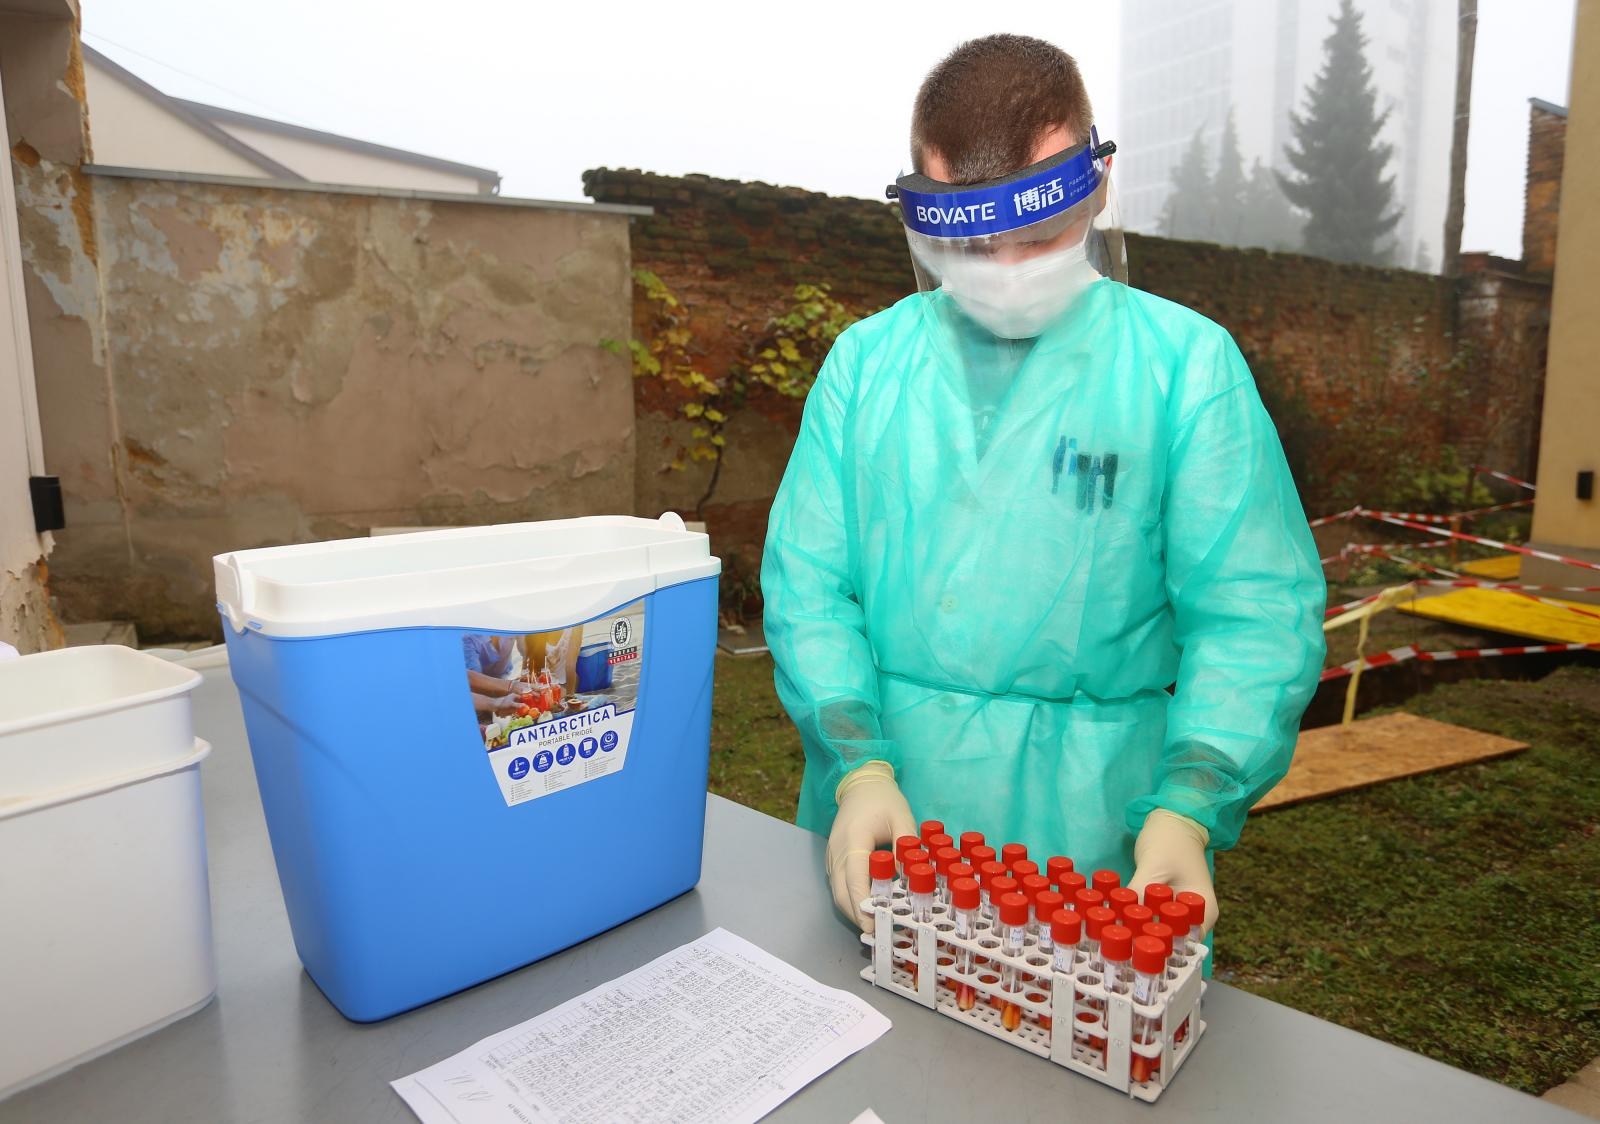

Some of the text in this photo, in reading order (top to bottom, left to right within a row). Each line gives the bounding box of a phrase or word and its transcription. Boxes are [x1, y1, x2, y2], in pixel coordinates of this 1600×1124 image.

[916, 202, 996, 225] BOVATE
[516, 709, 610, 746] ANTARCTICA
[538, 727, 593, 748] PORTABLE FRIDGE
